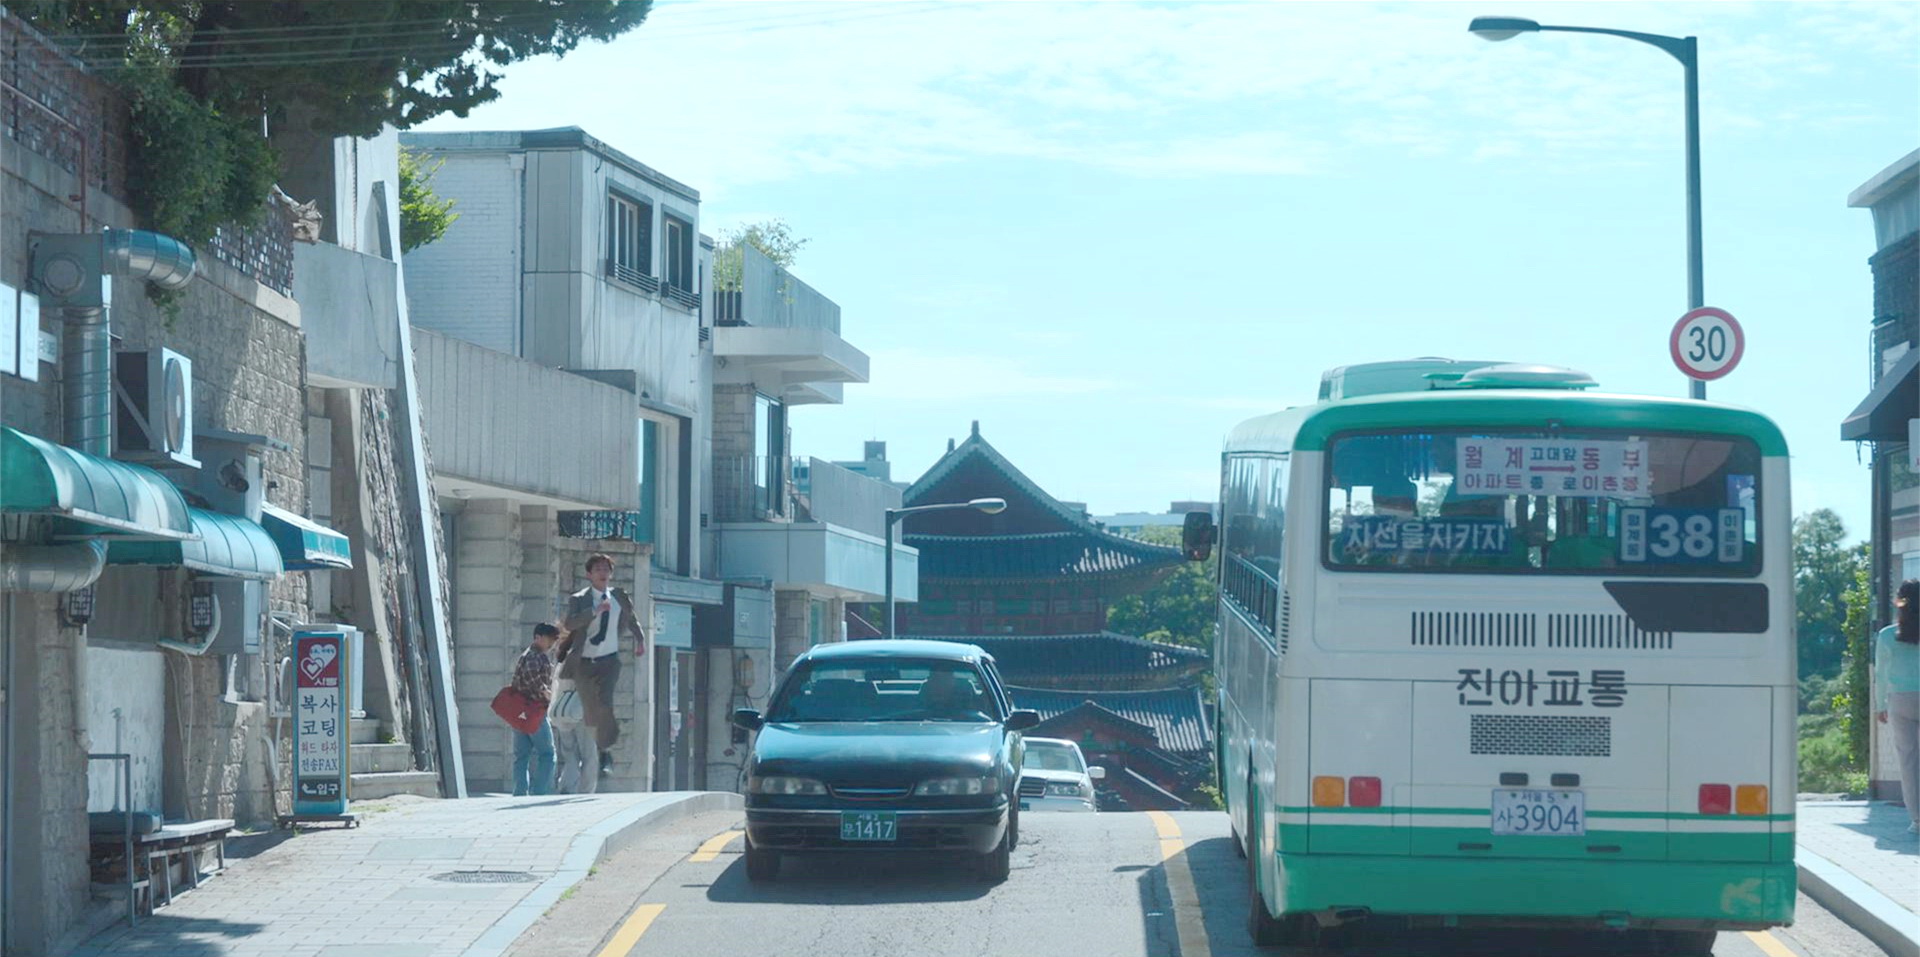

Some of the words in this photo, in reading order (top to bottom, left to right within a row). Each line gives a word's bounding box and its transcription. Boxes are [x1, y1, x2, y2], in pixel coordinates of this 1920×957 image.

[1688, 326, 1726, 362] 30
[1530, 447, 1577, 461] 고대앞
[1464, 474, 1523, 489] 아파트
[1650, 514, 1714, 557] 38
[1457, 668, 1628, 707] 진아교통
[300, 694, 338, 714] 복사
[301, 718, 336, 737] 코팅
[321, 741, 338, 755] 타자
[317, 783, 339, 795] 입구
